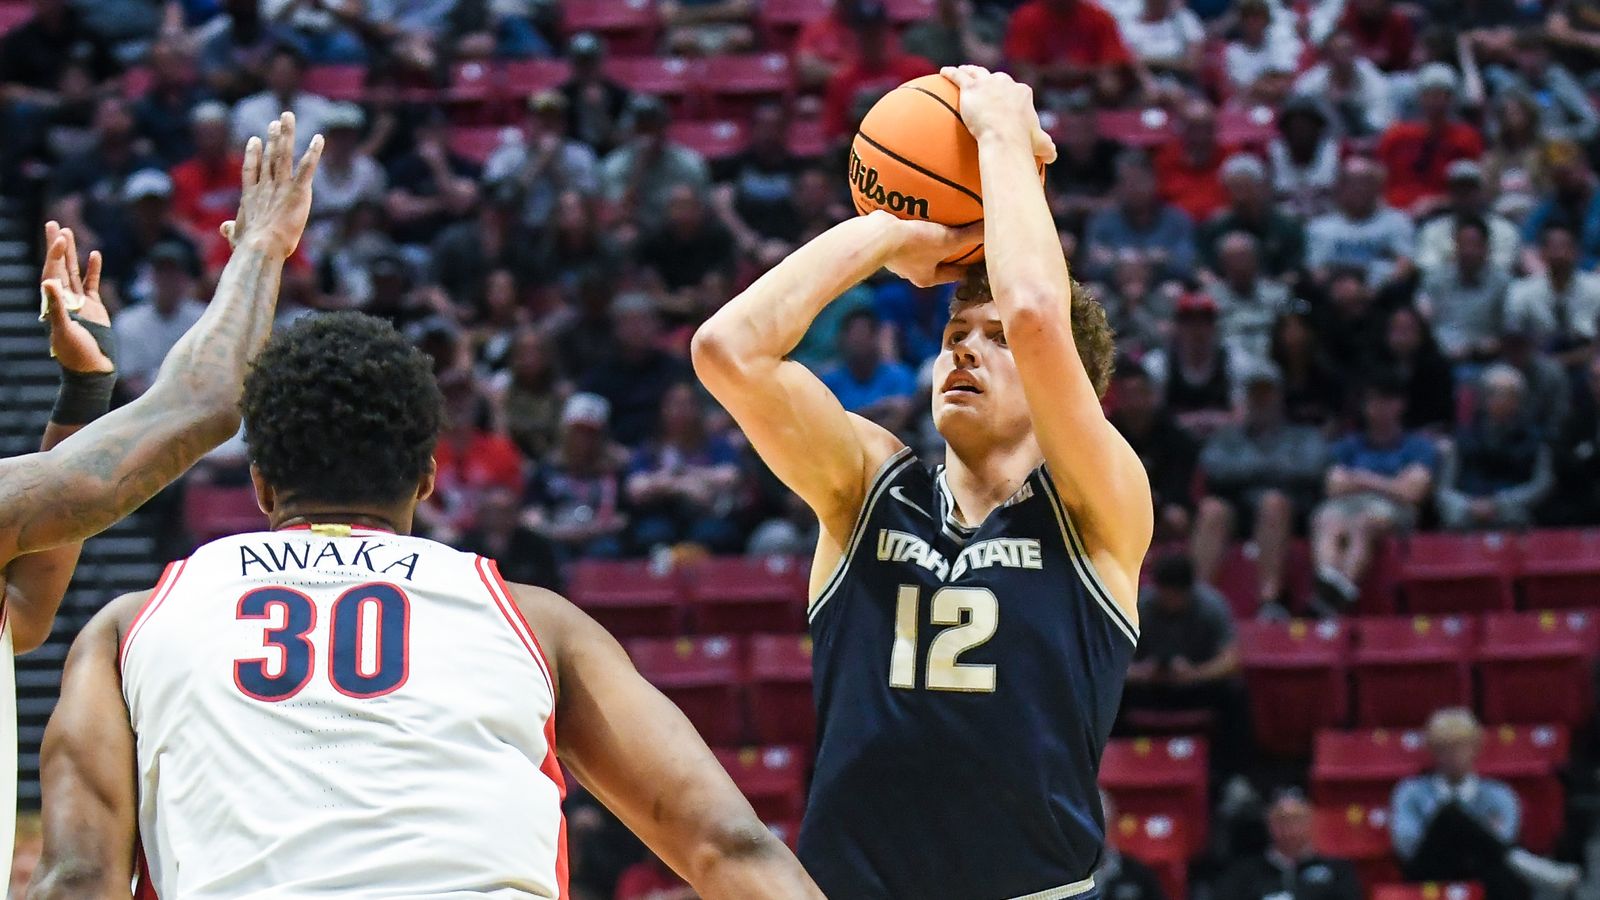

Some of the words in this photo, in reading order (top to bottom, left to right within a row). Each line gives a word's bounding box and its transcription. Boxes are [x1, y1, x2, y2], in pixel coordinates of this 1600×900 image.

[239, 540, 420, 582] AWAKA
[877, 528, 950, 583] UTAH
[948, 537, 1043, 583] STATE
[233, 581, 411, 702] 30
[889, 584, 999, 692] 12
